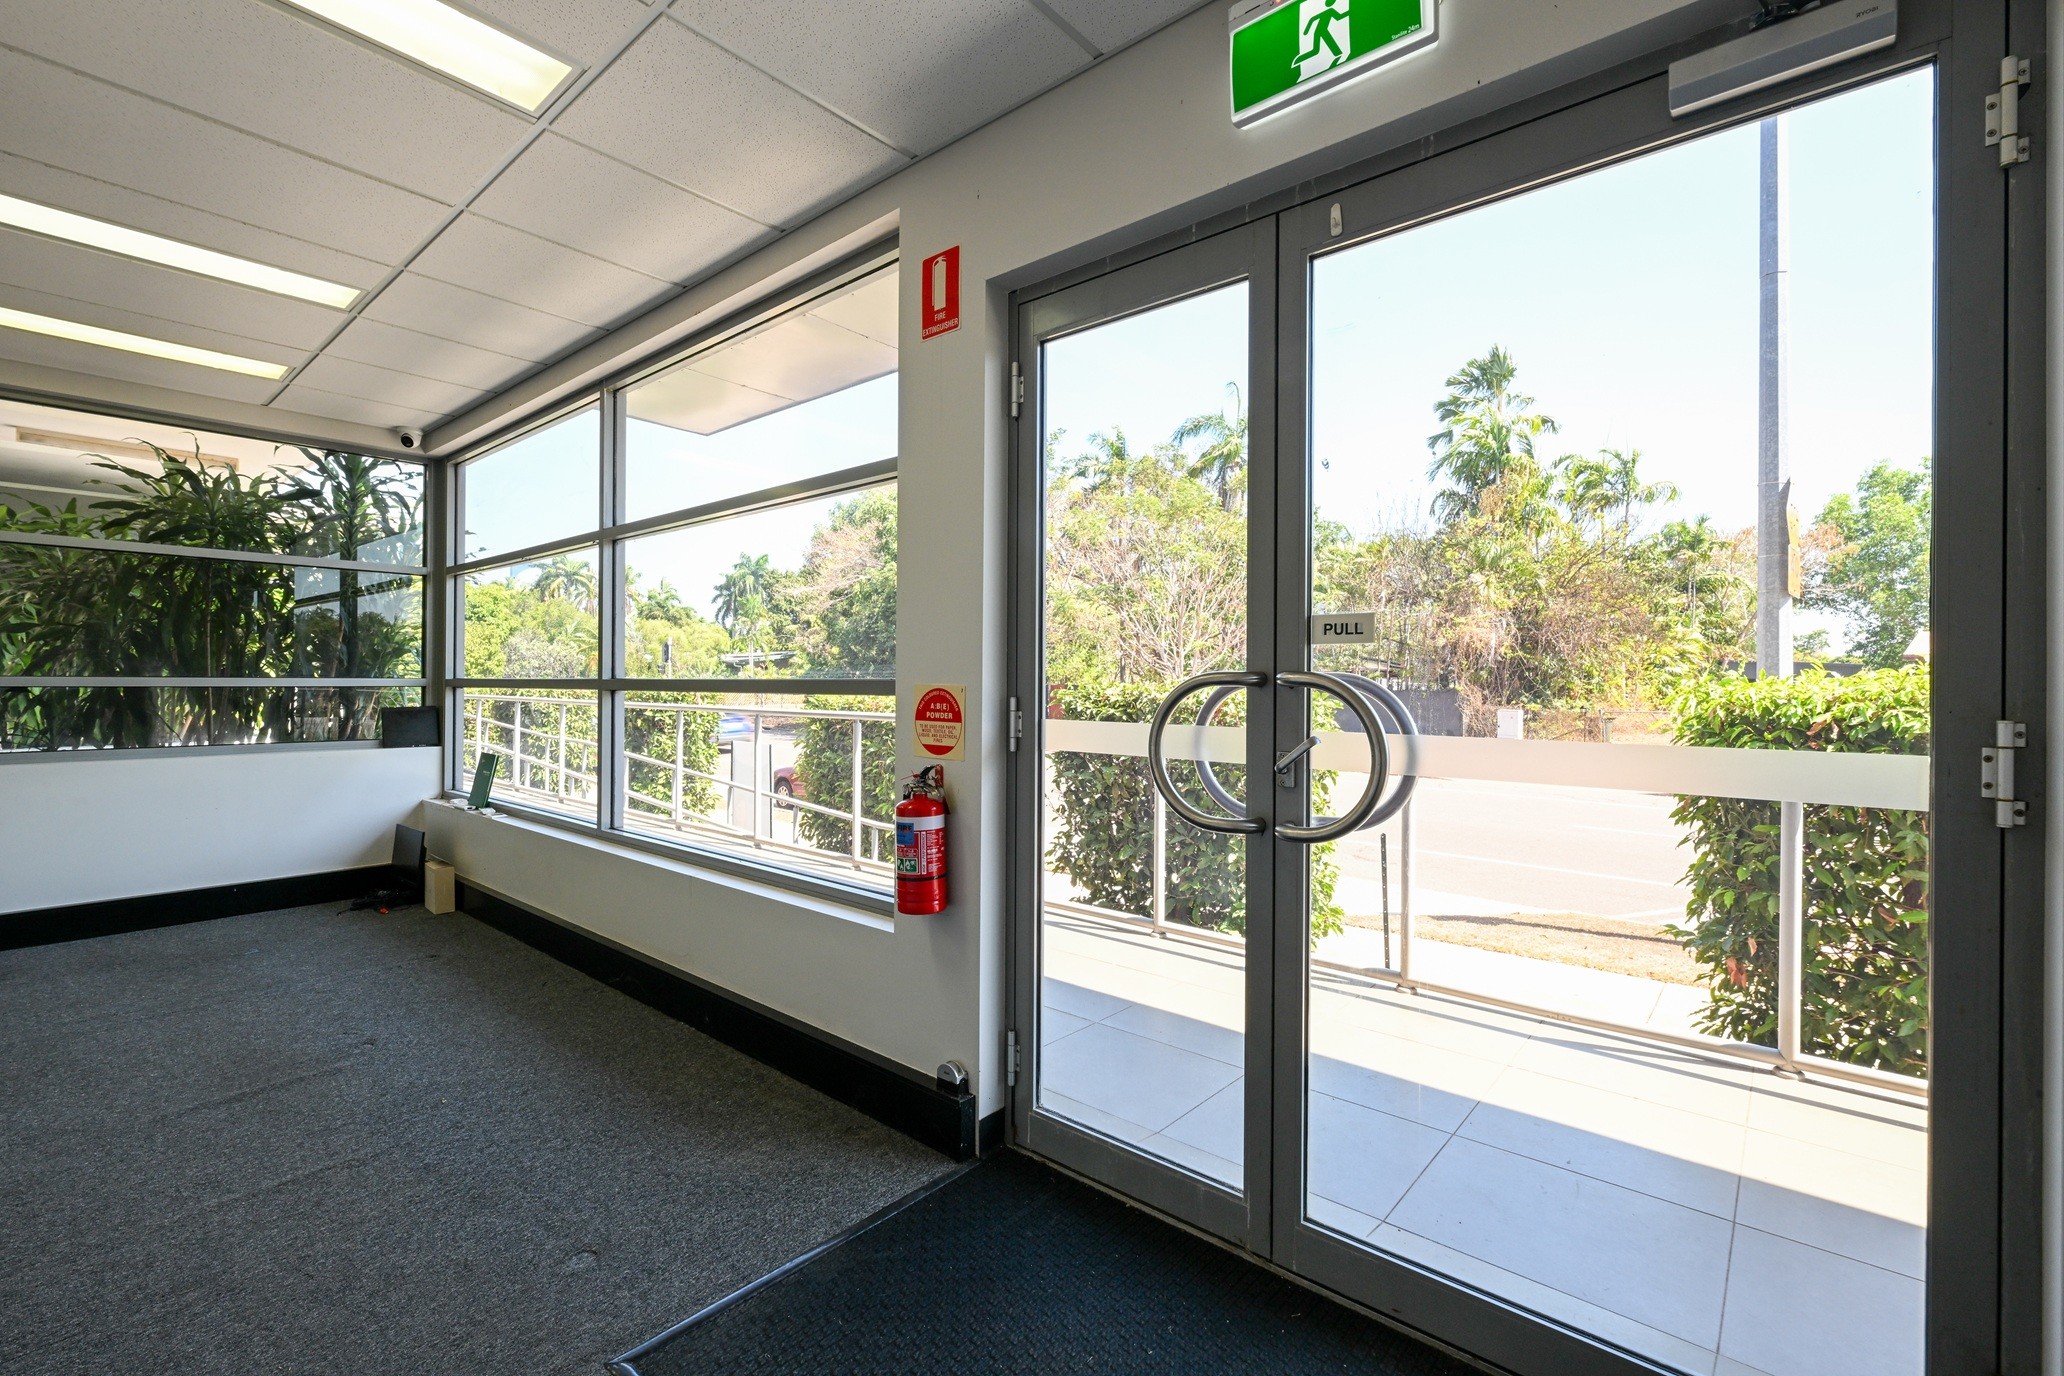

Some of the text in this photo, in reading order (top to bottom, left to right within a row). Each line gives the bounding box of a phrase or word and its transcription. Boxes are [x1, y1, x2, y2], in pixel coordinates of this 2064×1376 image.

[1407, 23, 1420, 33] 24m
[934, 311, 946, 322] FIRE
[922, 318, 958, 336] EXTINGUISHER
[1323, 622, 1364, 636] PULL
